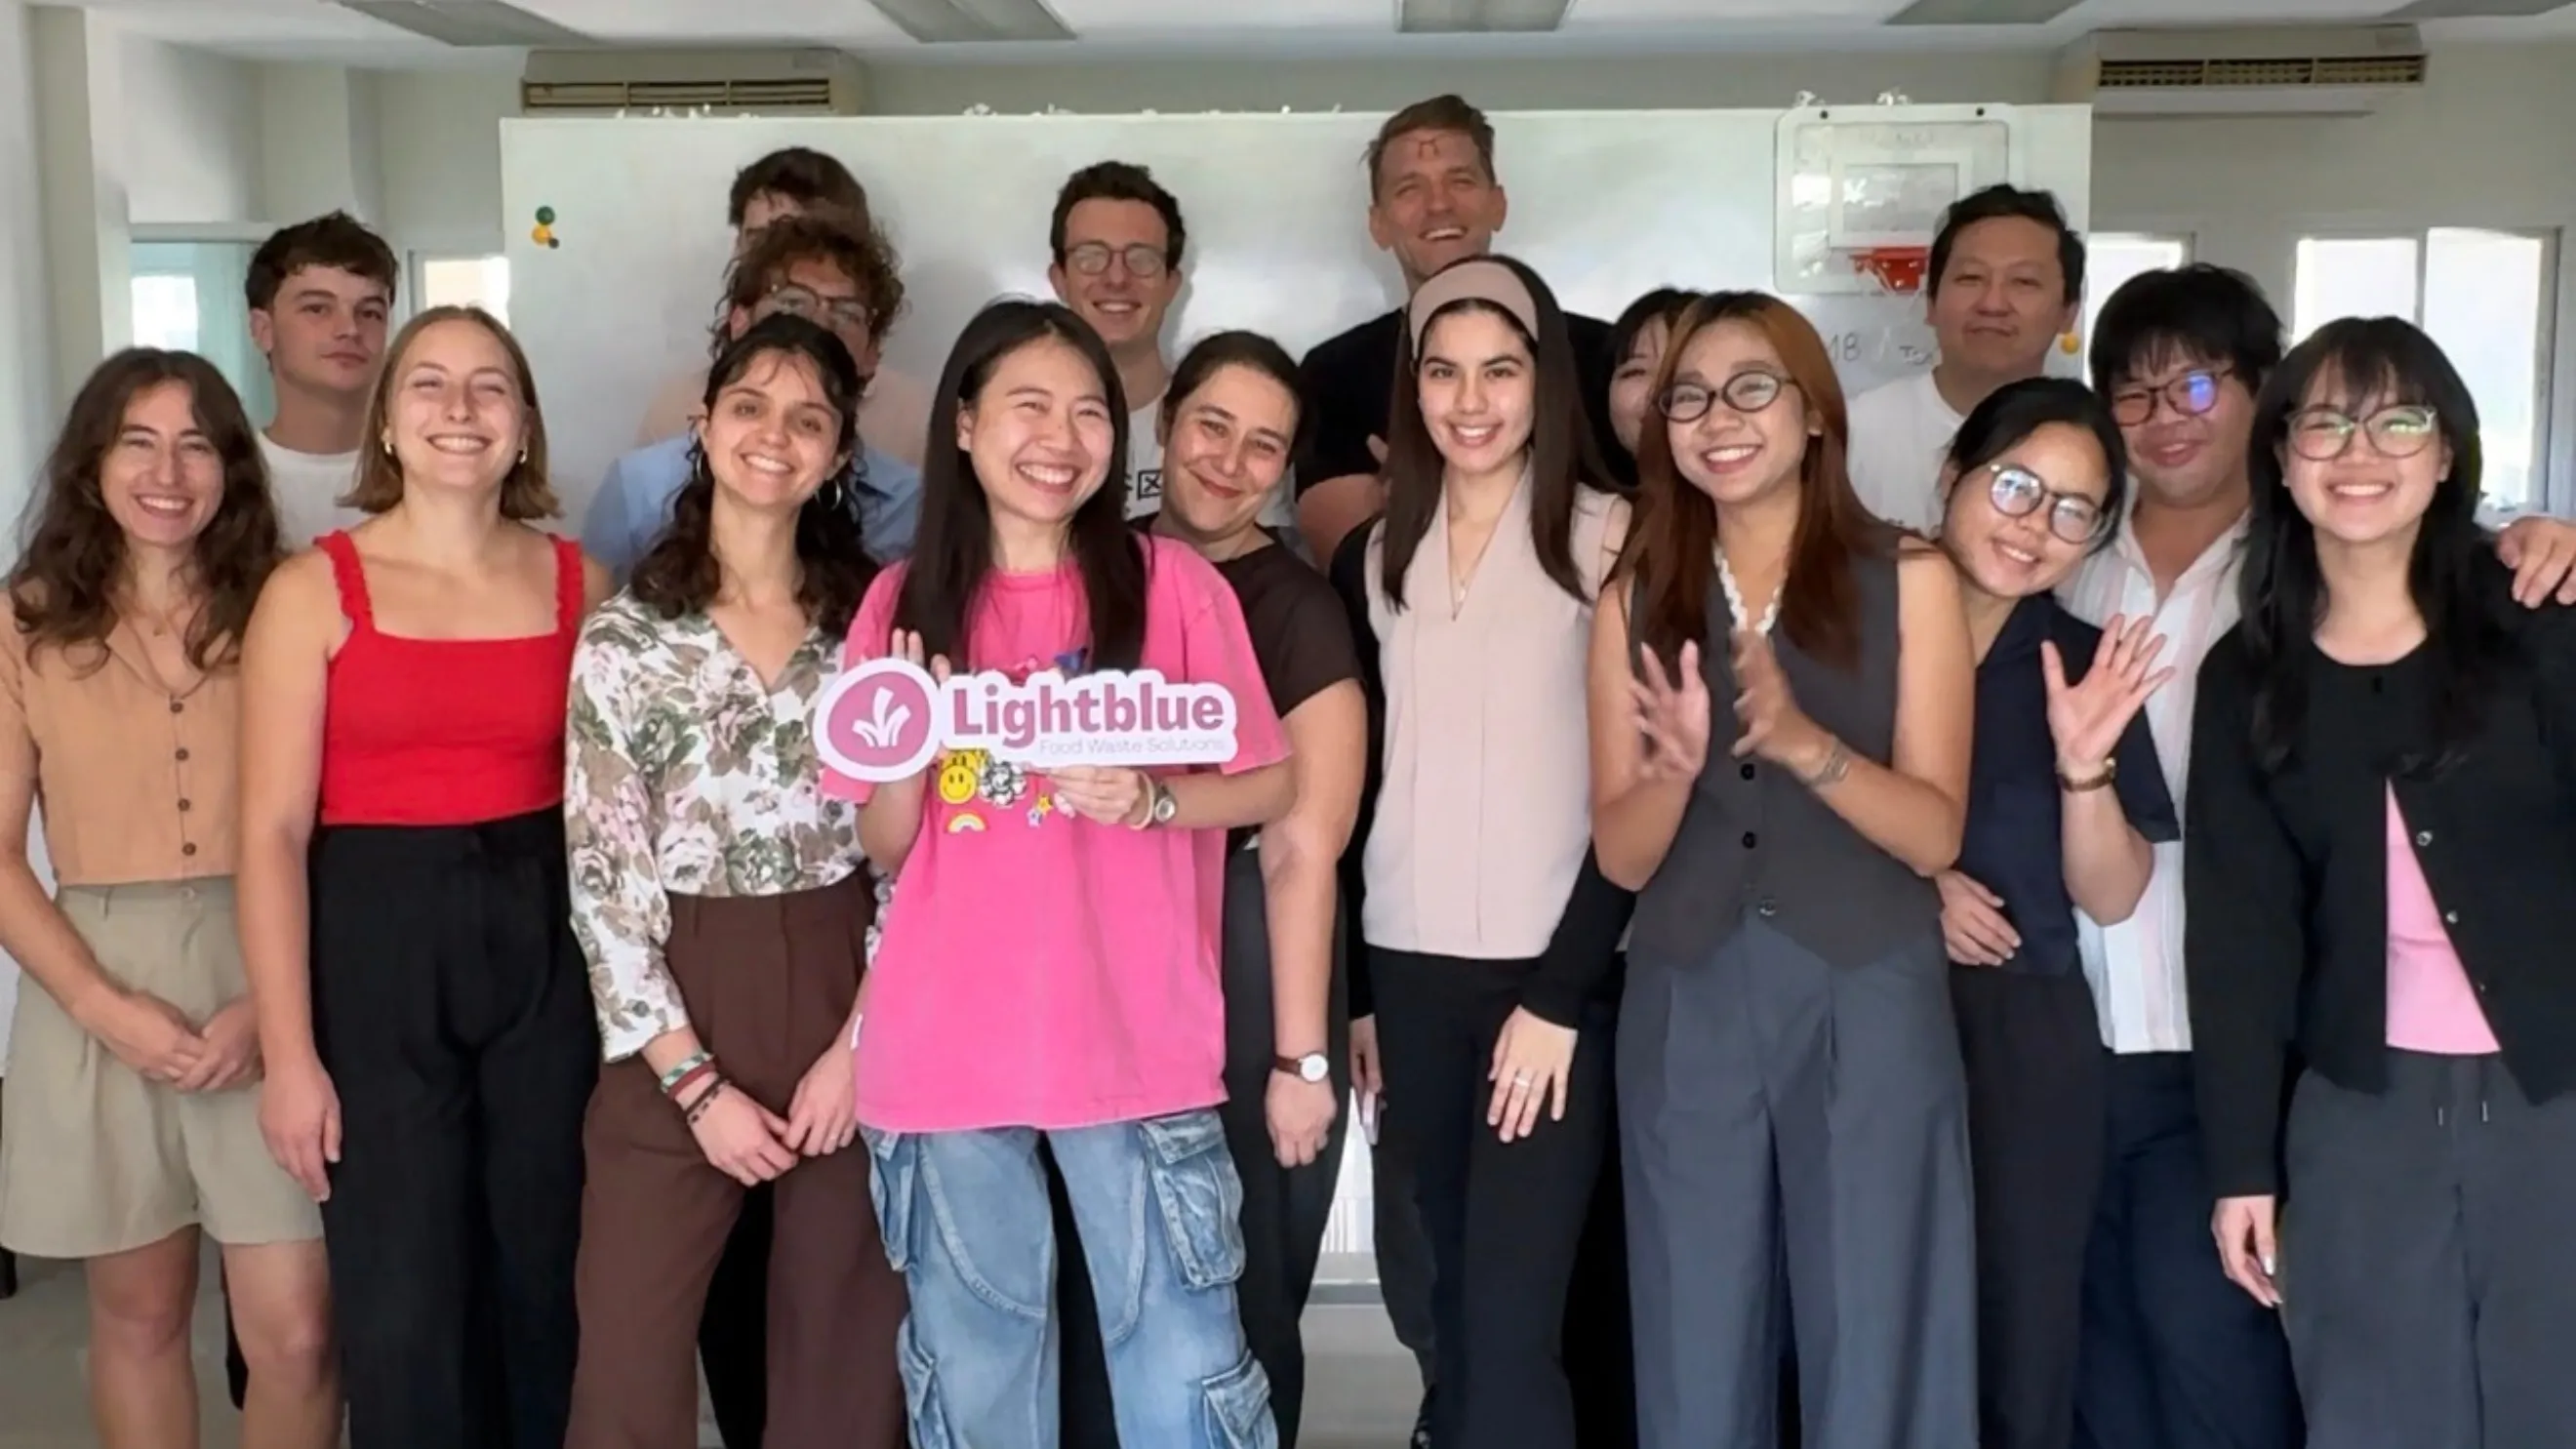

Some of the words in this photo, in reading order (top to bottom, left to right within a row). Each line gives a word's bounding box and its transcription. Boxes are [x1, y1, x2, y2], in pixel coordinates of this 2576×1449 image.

[953, 682, 1224, 748] Lightblue
[1040, 739, 1084, 755] Food
[1089, 738, 1142, 754] Waste
[1147, 736, 1226, 754] Solutions
